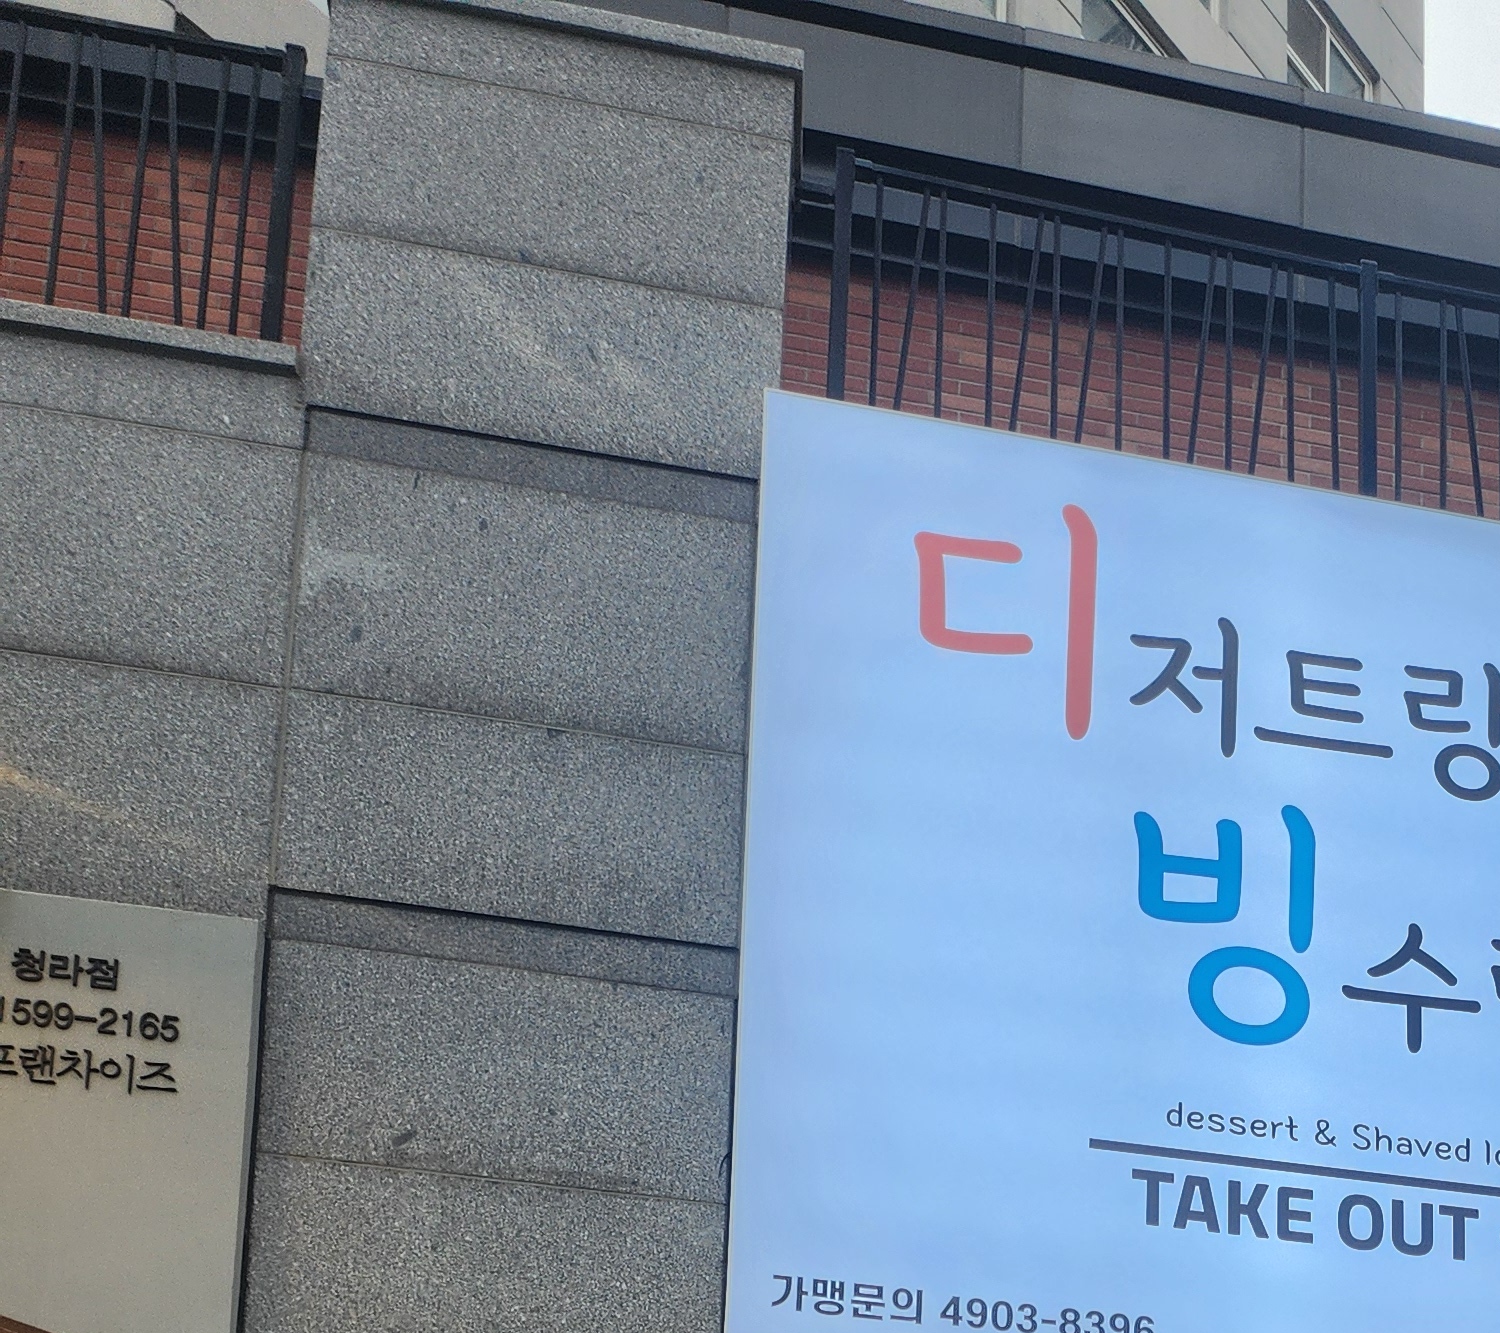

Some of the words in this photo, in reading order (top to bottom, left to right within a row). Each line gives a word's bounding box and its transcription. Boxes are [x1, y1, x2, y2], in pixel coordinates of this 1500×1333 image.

[11, 947, 119, 991] 청라점
[0, 996, 180, 1043] 1599-2165
[1166, 1101, 1299, 1142] dessert
[1314, 1119, 1337, 1146] &
[1352, 1123, 1471, 1164] Shaved
[1131, 1167, 1315, 1245] TAKE
[1337, 1192, 1479, 1262] OUT
[771, 1273, 925, 1326] 가맹문의
